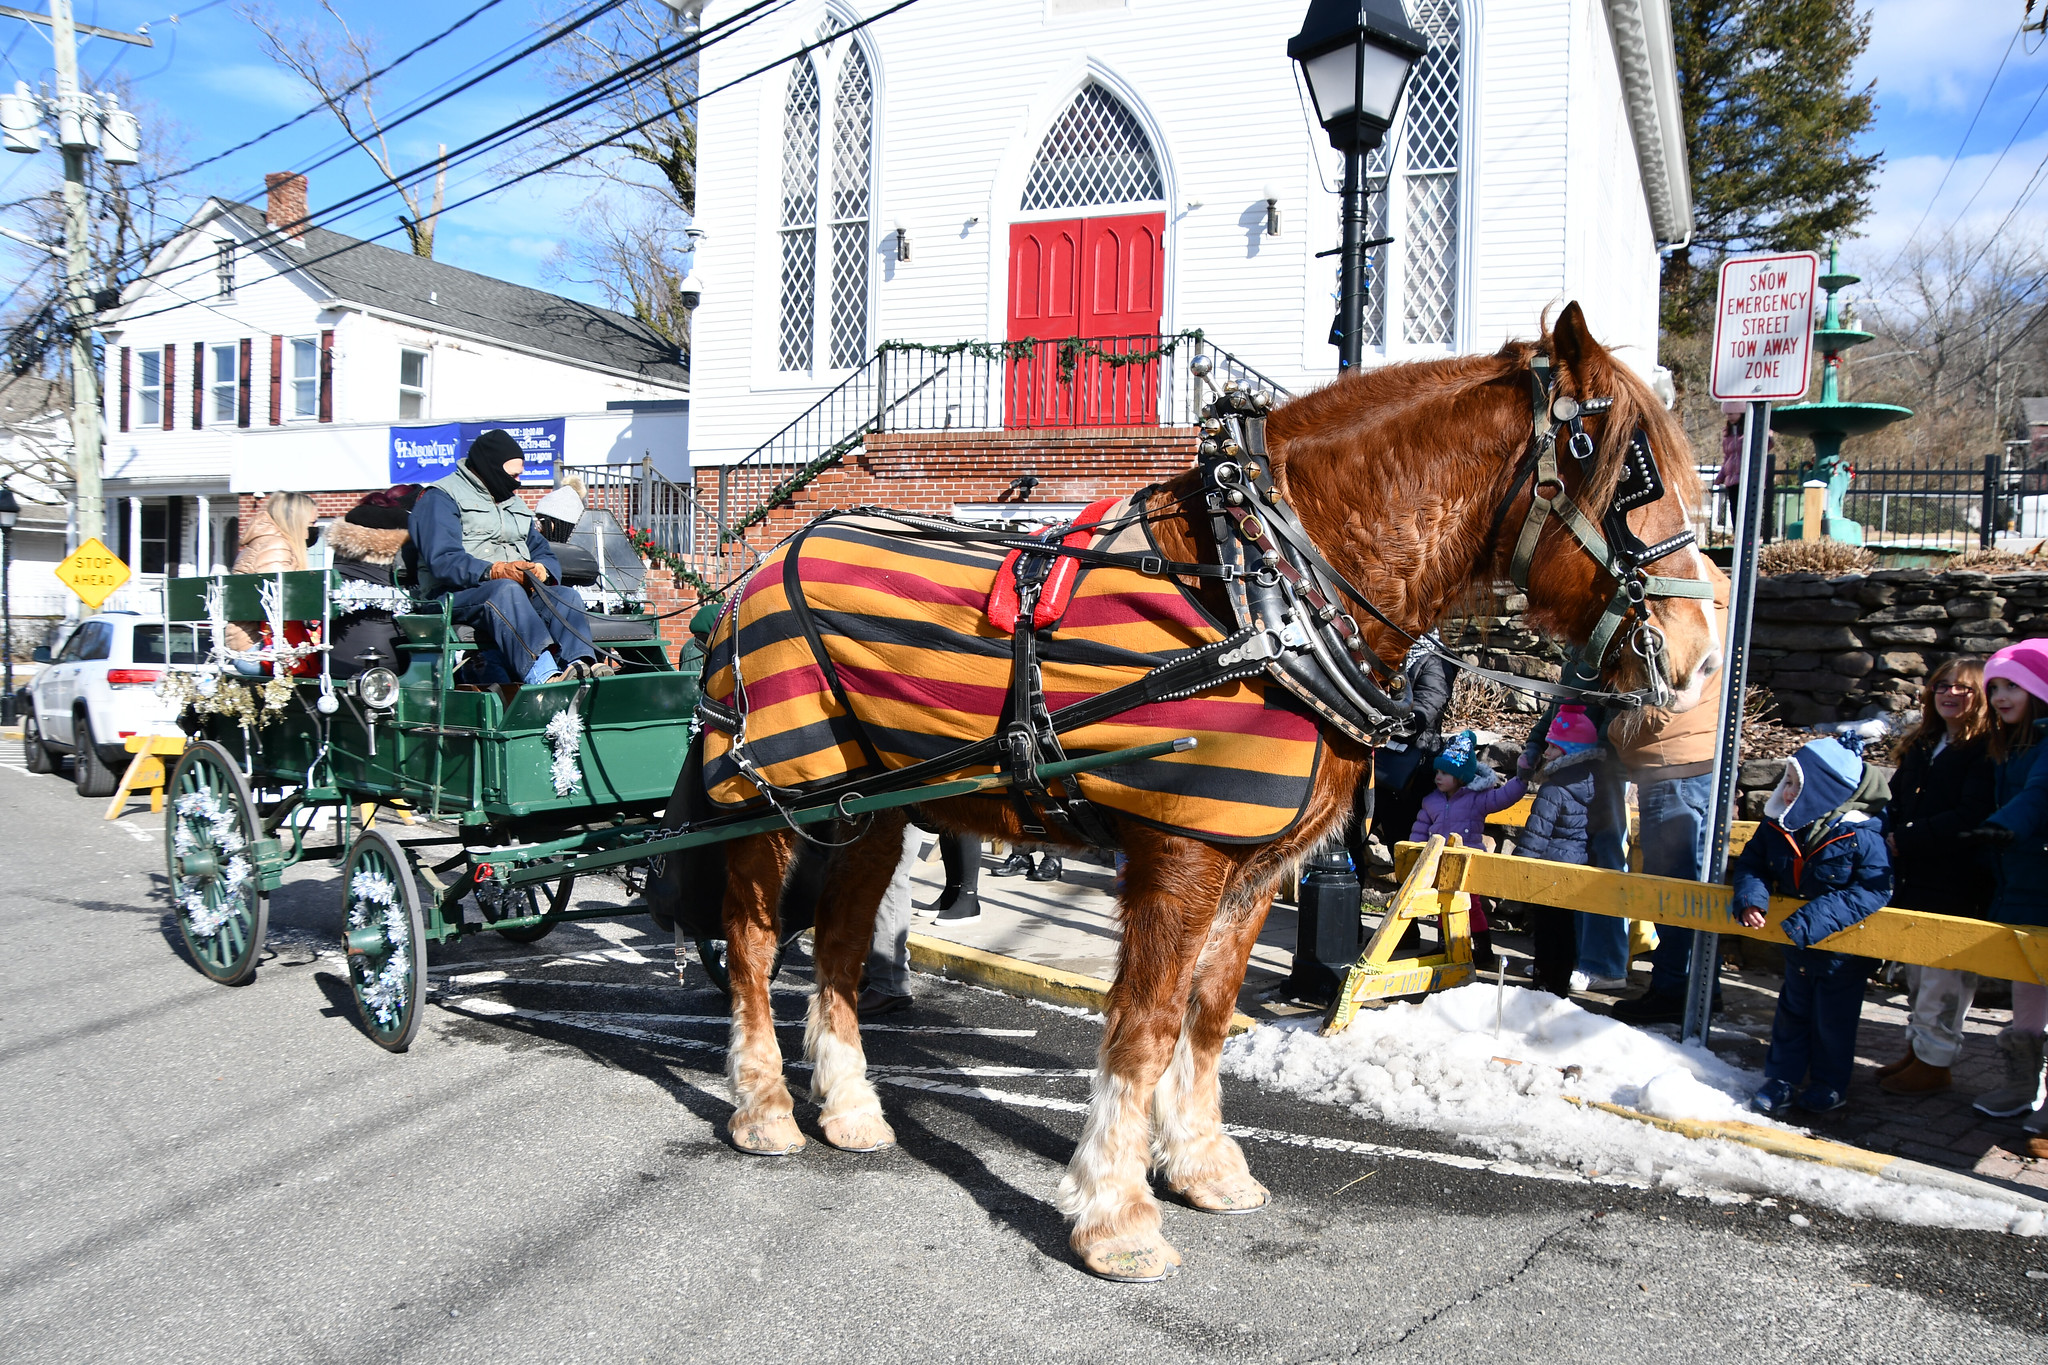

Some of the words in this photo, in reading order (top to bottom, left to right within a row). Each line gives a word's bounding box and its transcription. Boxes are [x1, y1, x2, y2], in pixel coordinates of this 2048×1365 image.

[1749, 272, 1788, 291] SNOW
[1727, 291, 1808, 315] EMERGENCY
[1742, 315, 1790, 336] STREET
[1731, 340, 1757, 358] TOW
[1763, 336, 1799, 356] AWAY
[1744, 360, 1781, 379] ZONE
[76, 557, 112, 568] STOP
[73, 575, 114, 586] AHEAD
